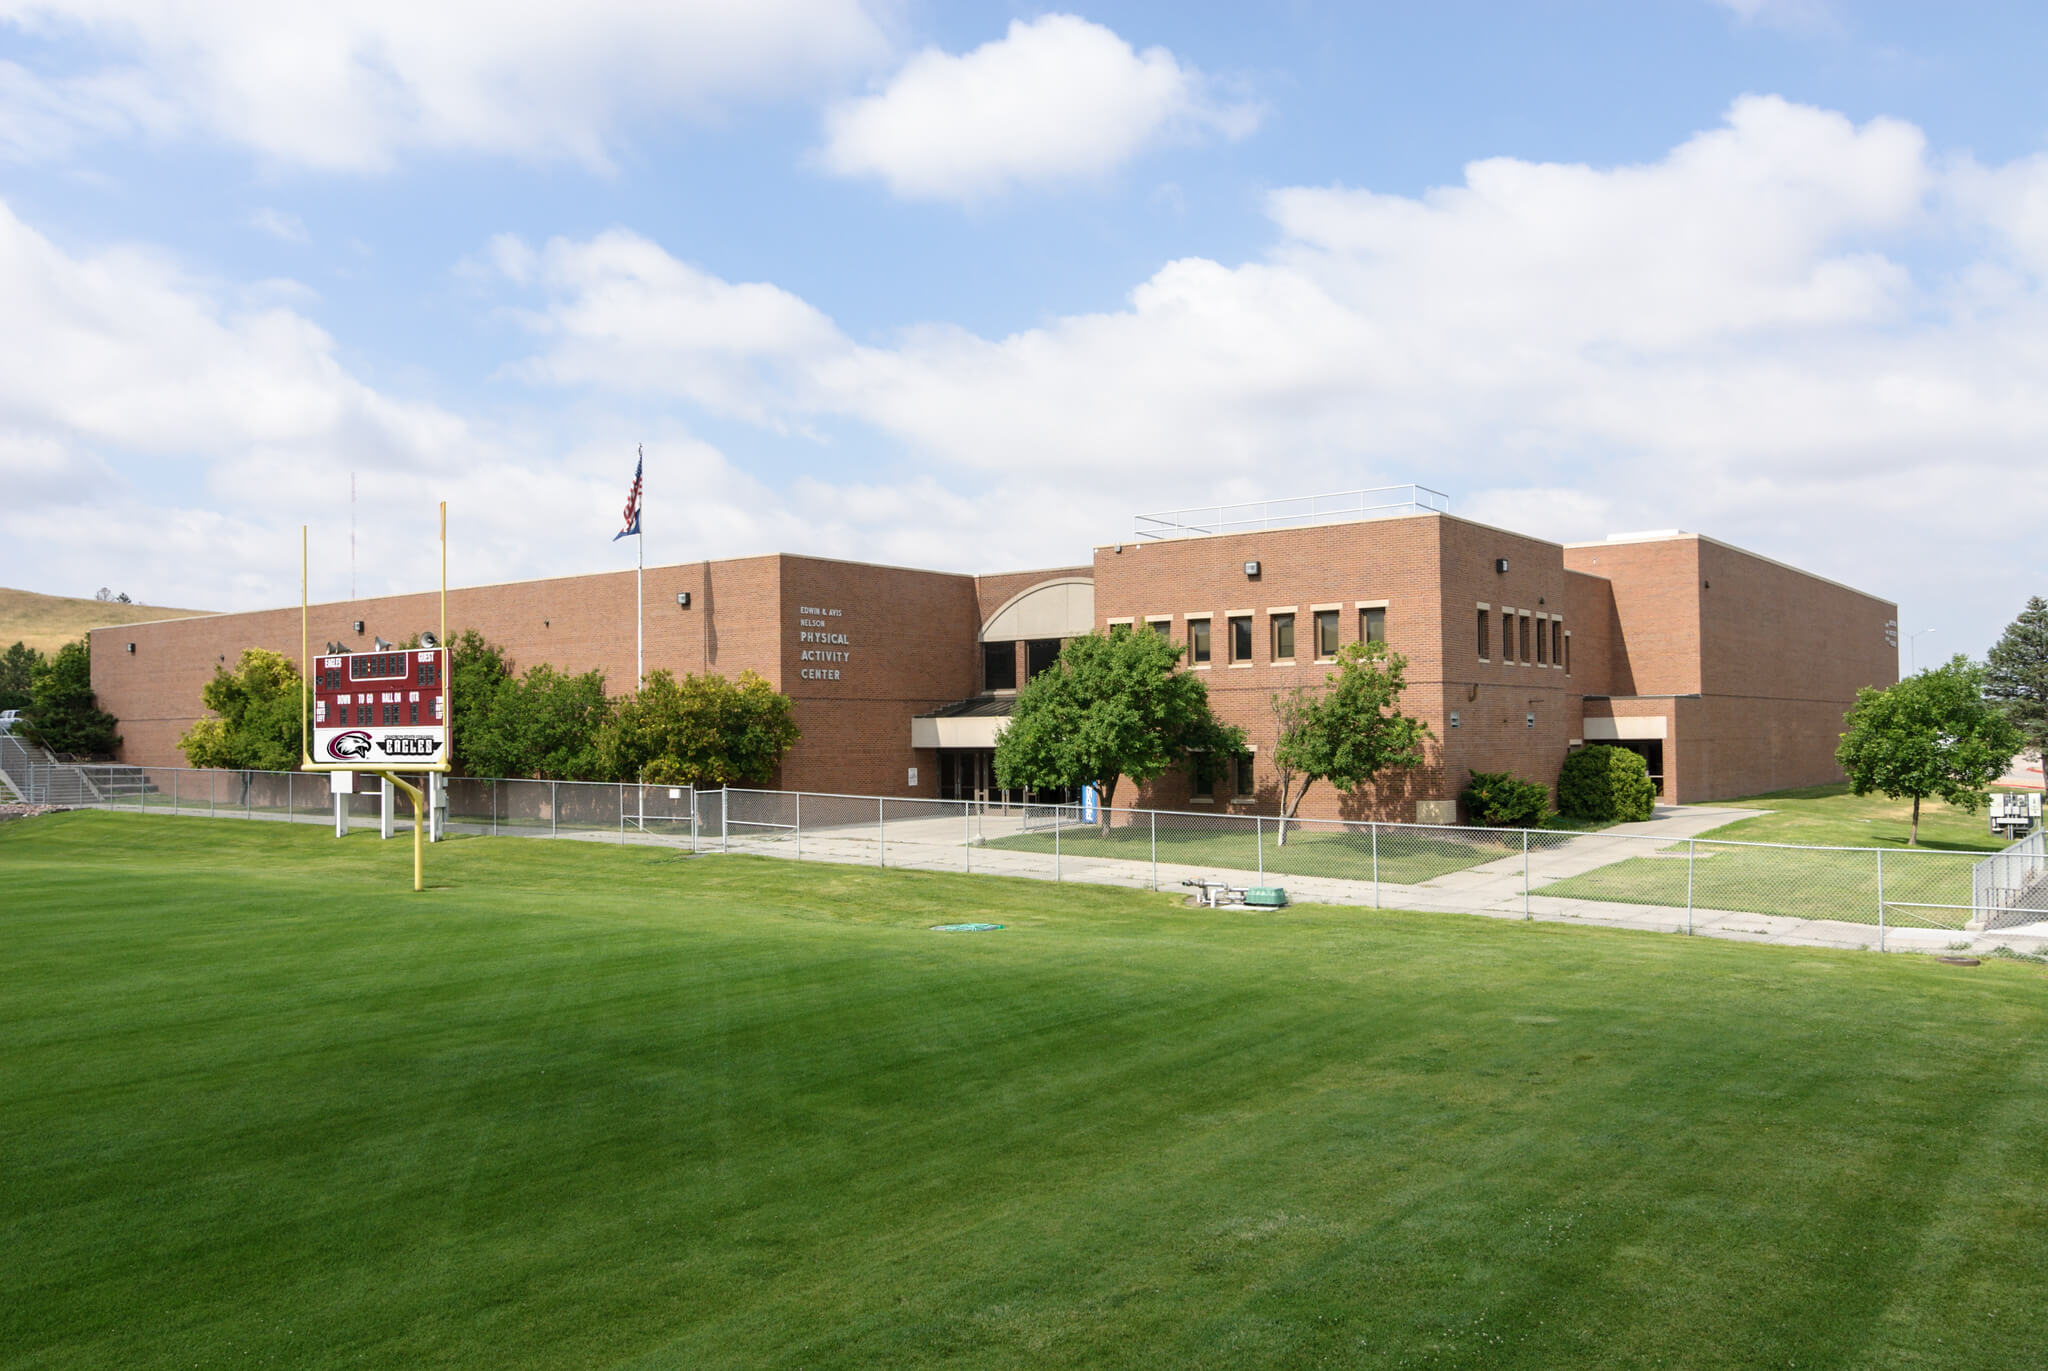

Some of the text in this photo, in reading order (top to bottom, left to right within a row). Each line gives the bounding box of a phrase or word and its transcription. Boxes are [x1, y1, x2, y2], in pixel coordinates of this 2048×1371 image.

[801, 607, 820, 615] EDWIN
[822, 608, 827, 616] &
[800, 619, 825, 627] NELSON
[801, 632, 849, 645] PHYSICAL
[418, 652, 434, 662] GUEST
[801, 650, 849, 662] ACTIVITY
[801, 669, 840, 680] CENTER
[385, 739, 434, 755] EAGLES
